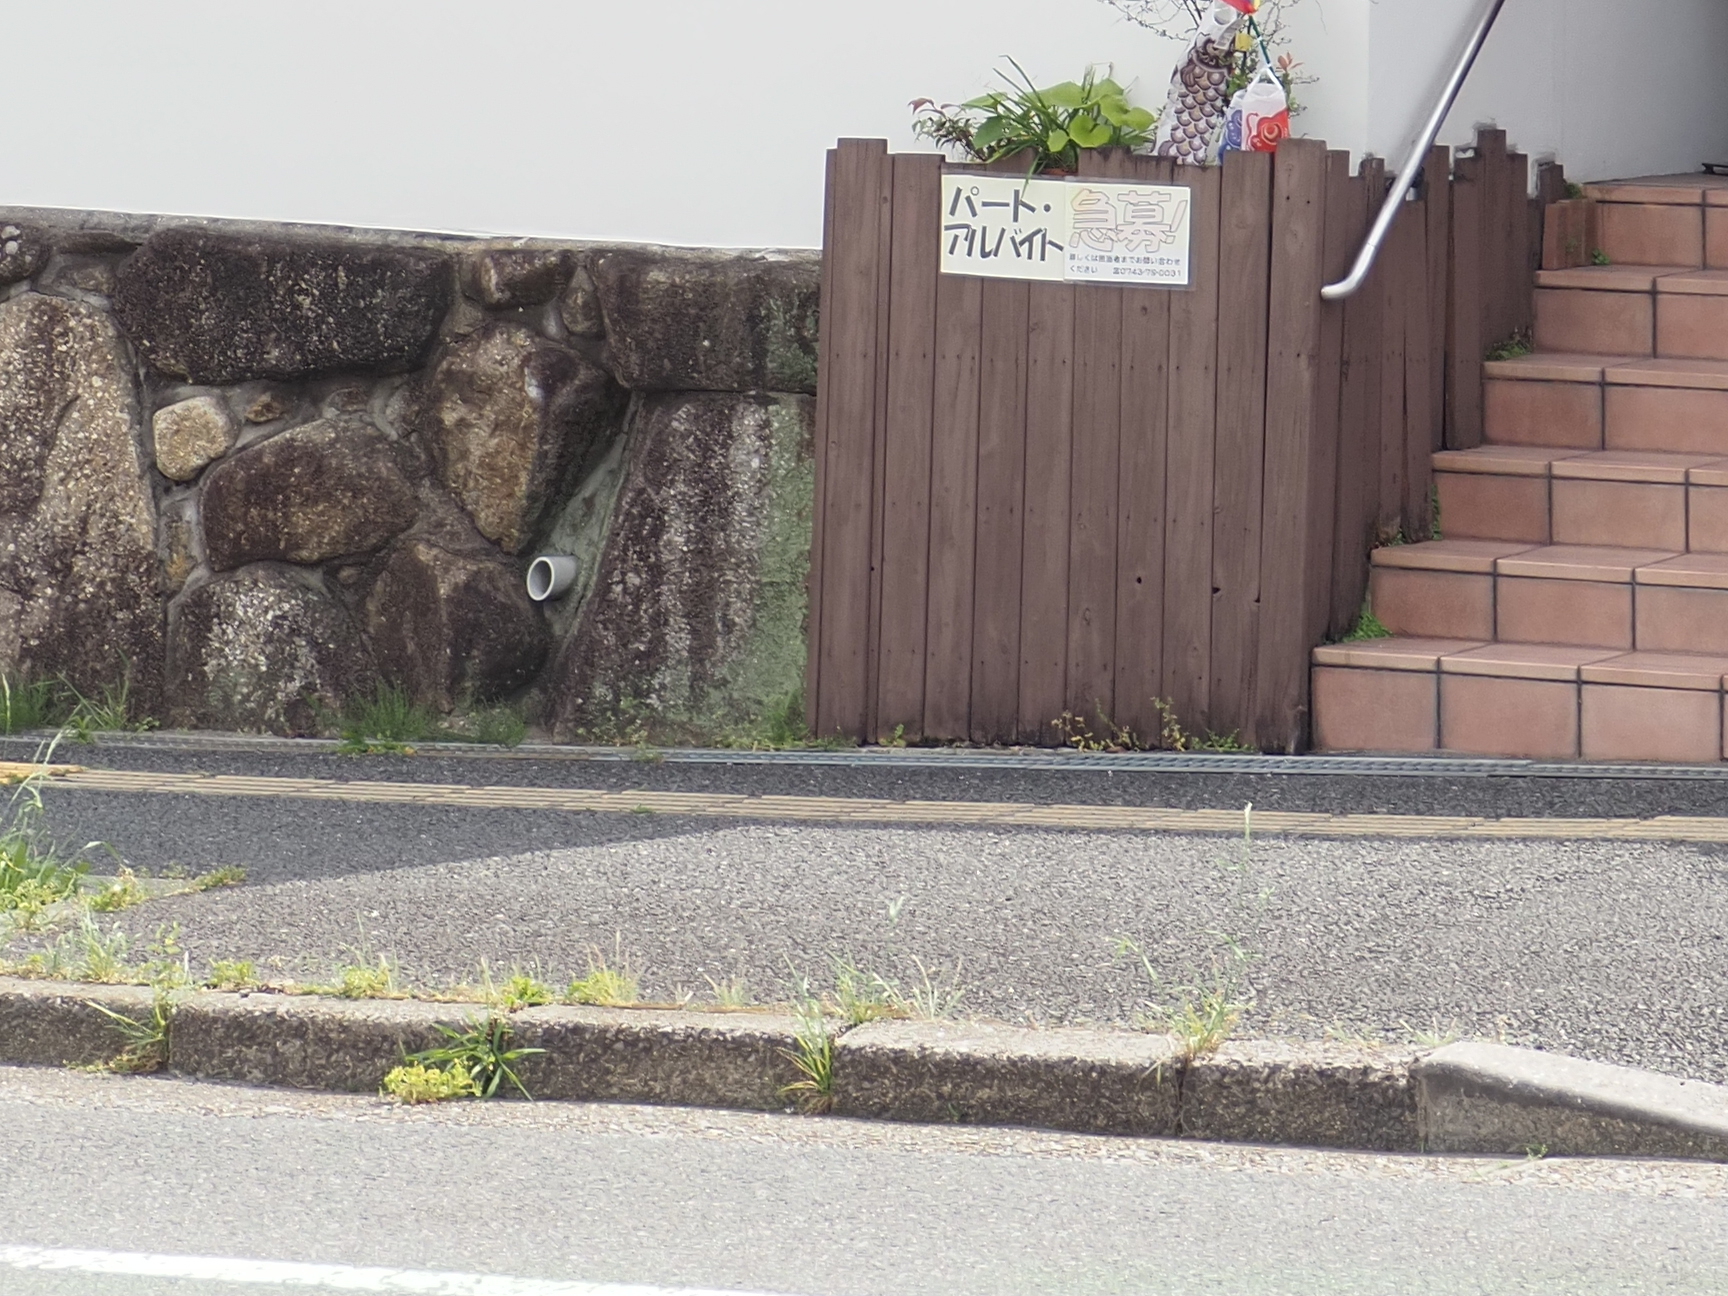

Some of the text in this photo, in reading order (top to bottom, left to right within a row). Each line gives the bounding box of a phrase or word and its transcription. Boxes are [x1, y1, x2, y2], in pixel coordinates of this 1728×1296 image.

[944, 223, 1064, 262] アルバイト
